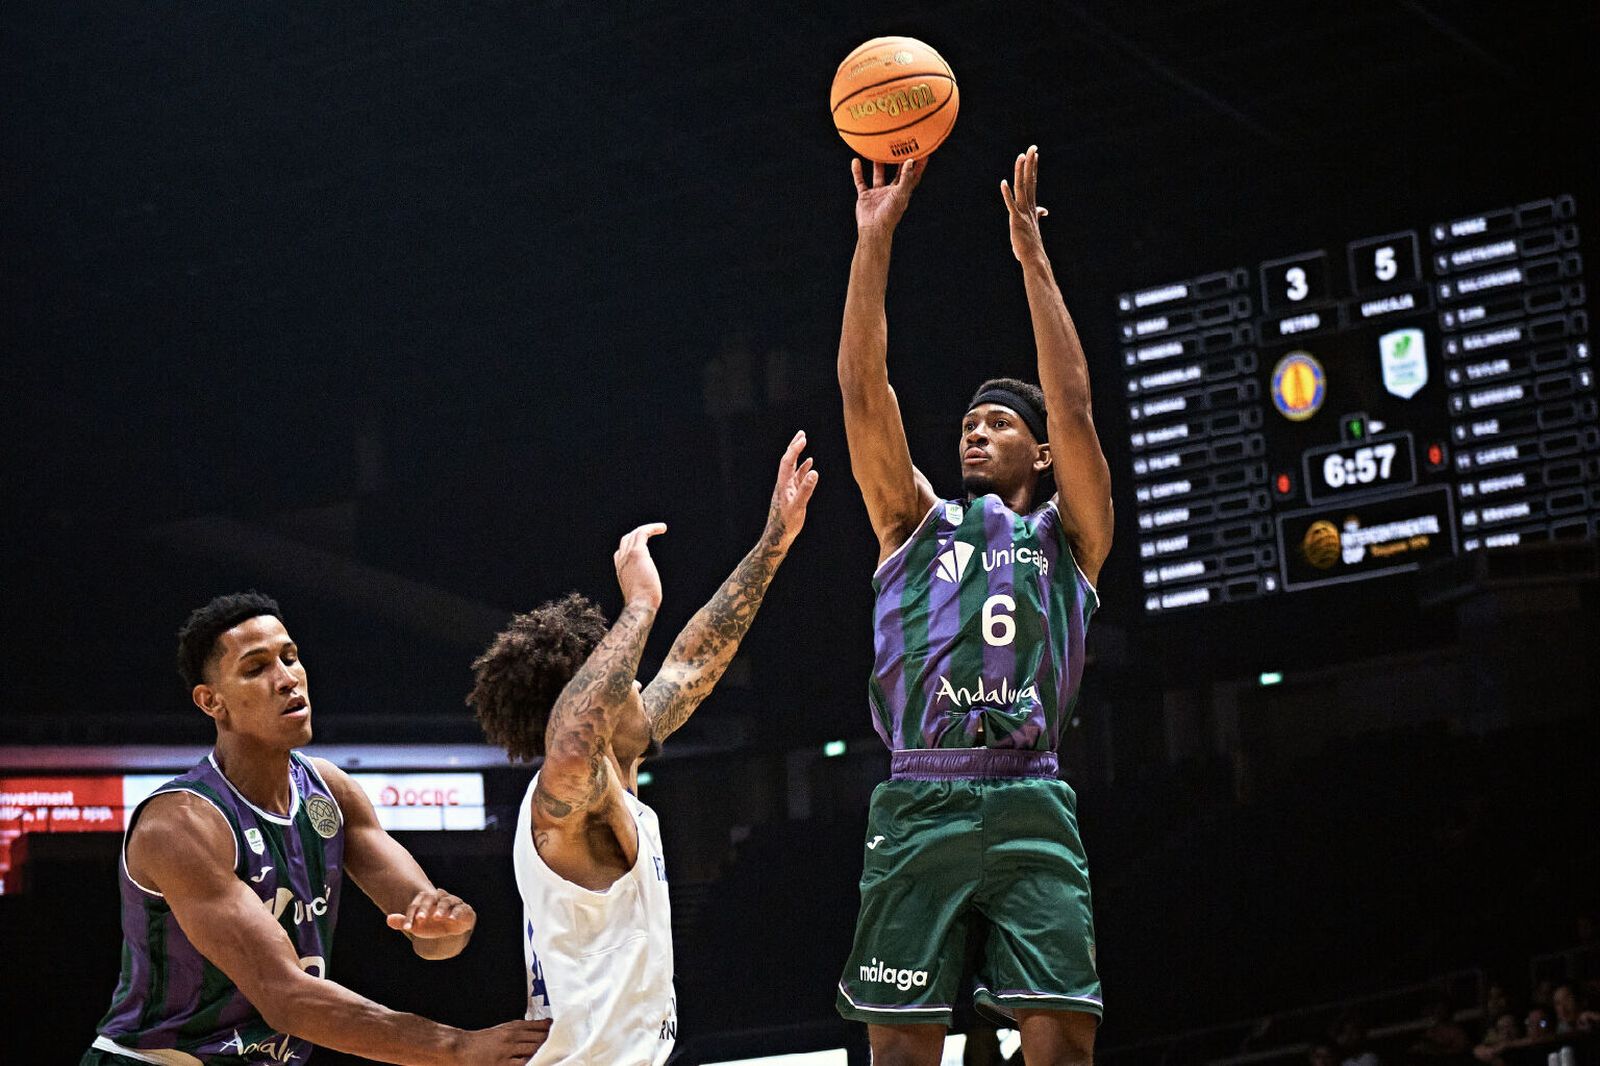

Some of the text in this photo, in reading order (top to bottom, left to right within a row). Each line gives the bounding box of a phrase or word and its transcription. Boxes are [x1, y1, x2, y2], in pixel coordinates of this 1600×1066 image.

[849, 83, 936, 120] Wilson
[1375, 246, 1397, 281] 5
[1286, 267, 1309, 300] 3
[1323, 443, 1396, 488] 6:57
[981, 542, 1049, 577] Unicaja
[982, 594, 1016, 646] 6
[404, 786, 460, 806] OCBC
[859, 957, 928, 991] málaga
